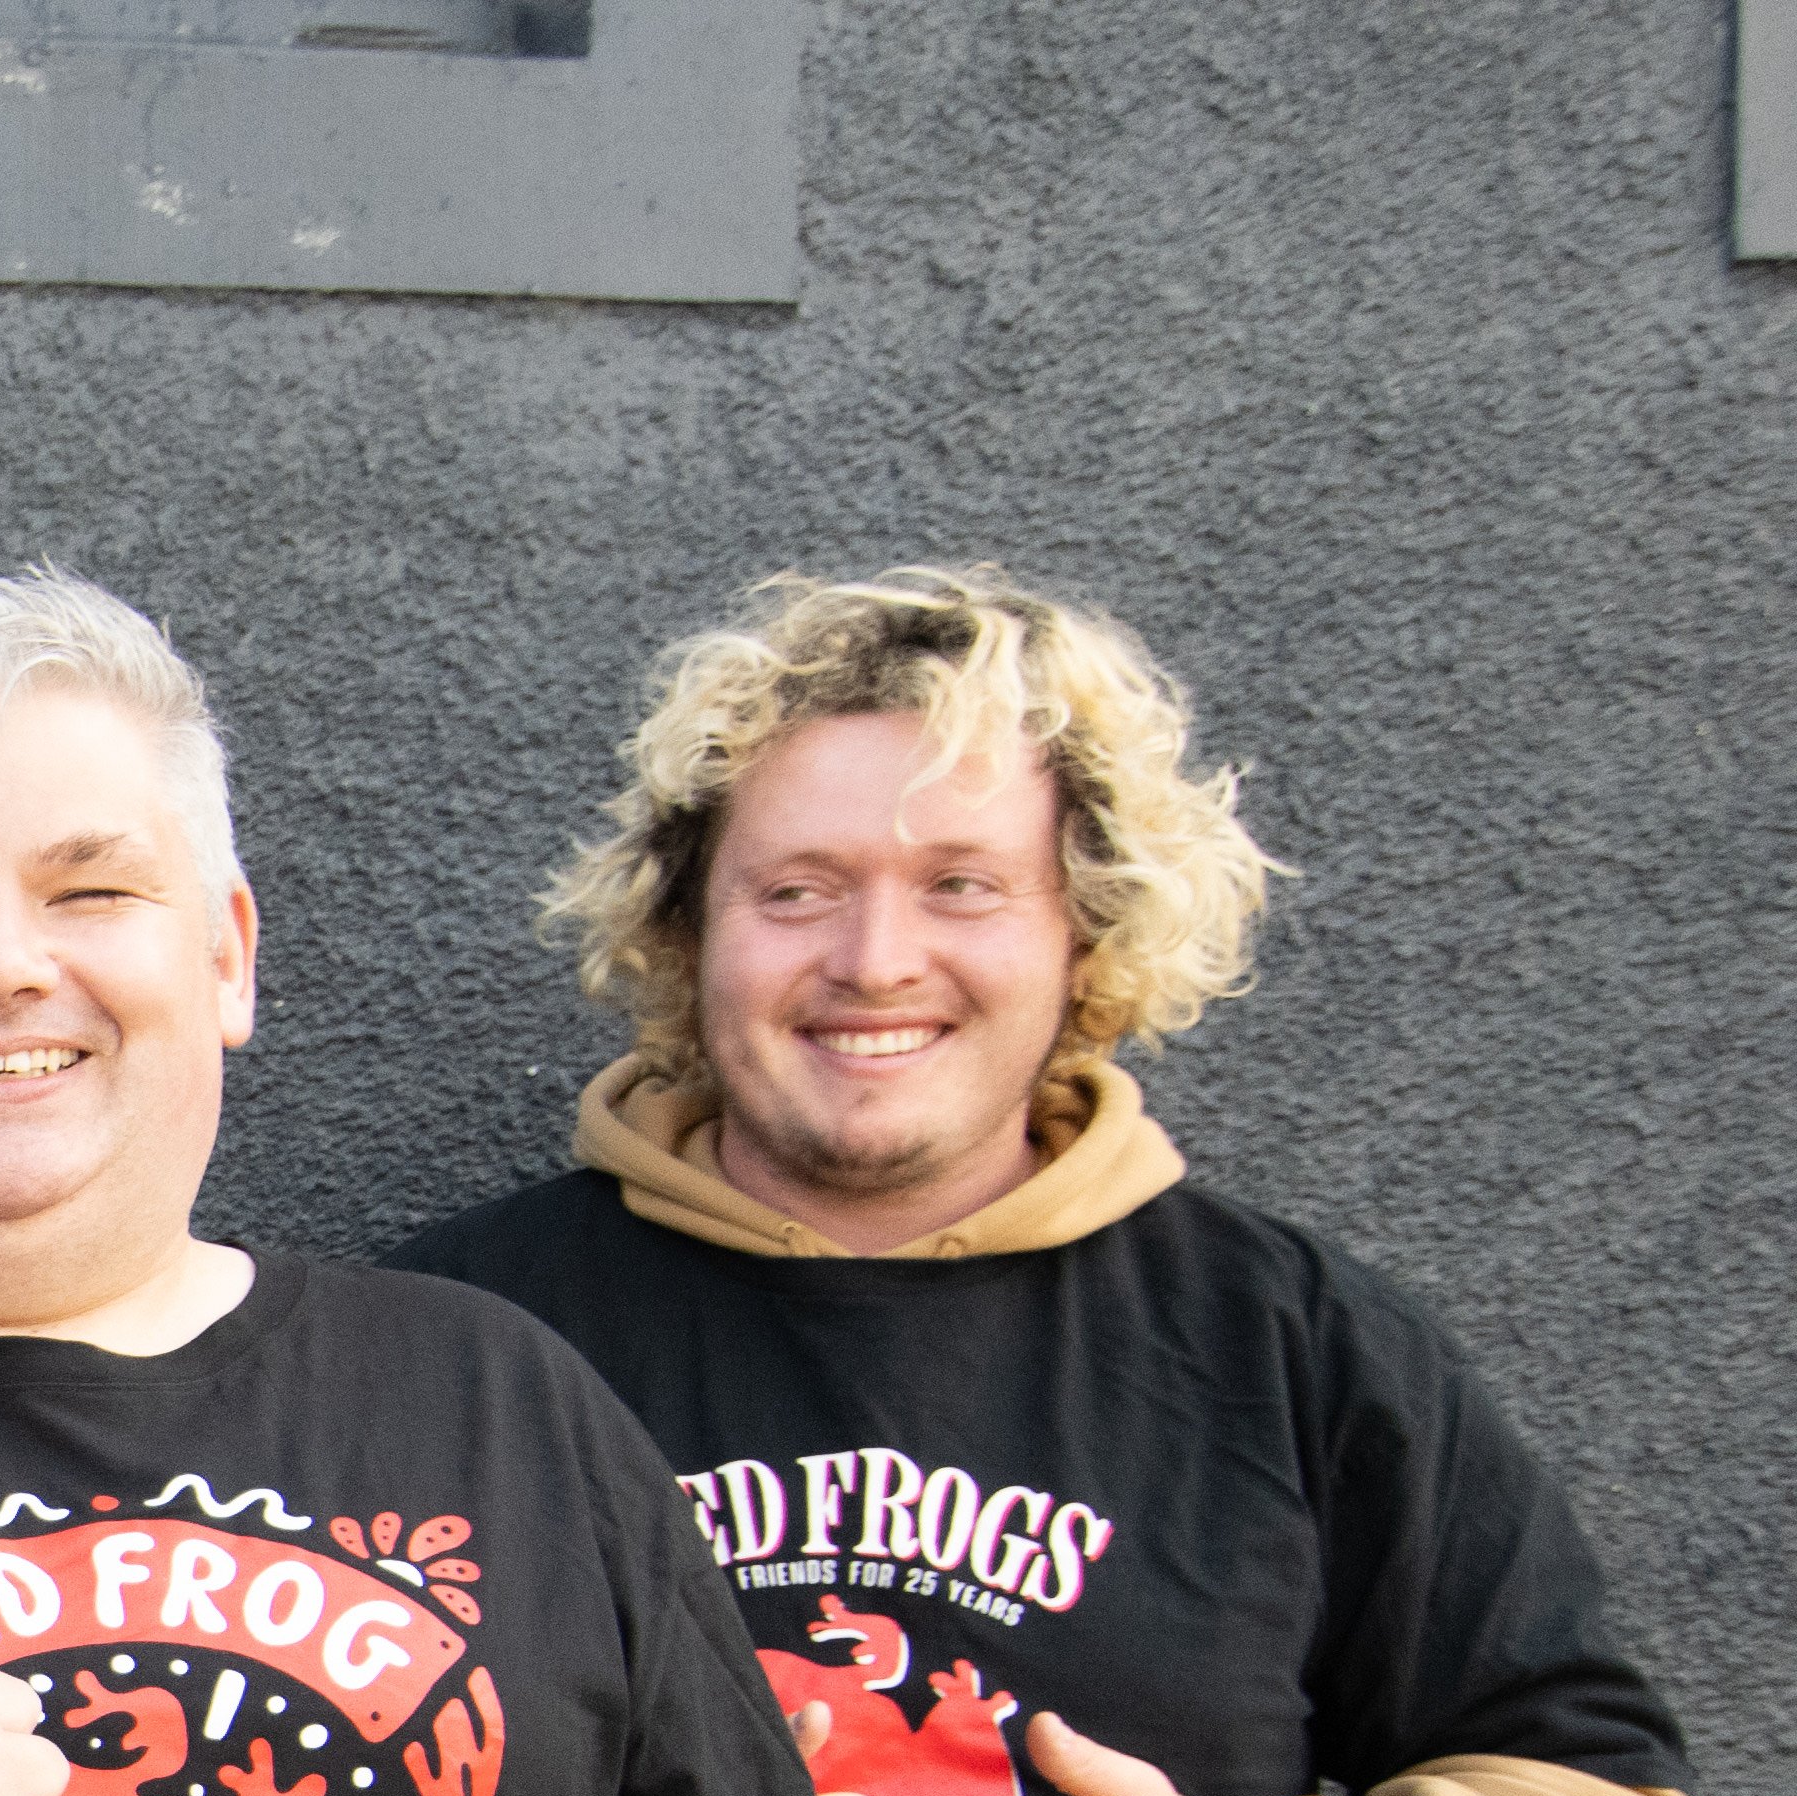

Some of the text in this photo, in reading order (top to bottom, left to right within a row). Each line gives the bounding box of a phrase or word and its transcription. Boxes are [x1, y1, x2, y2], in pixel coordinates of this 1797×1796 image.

[91, 1529, 411, 1690] FROG
[675, 1447, 1114, 1613] ED FROGS
[737, 1560, 1026, 1628] FRIENDS FOR 25 YEARS
